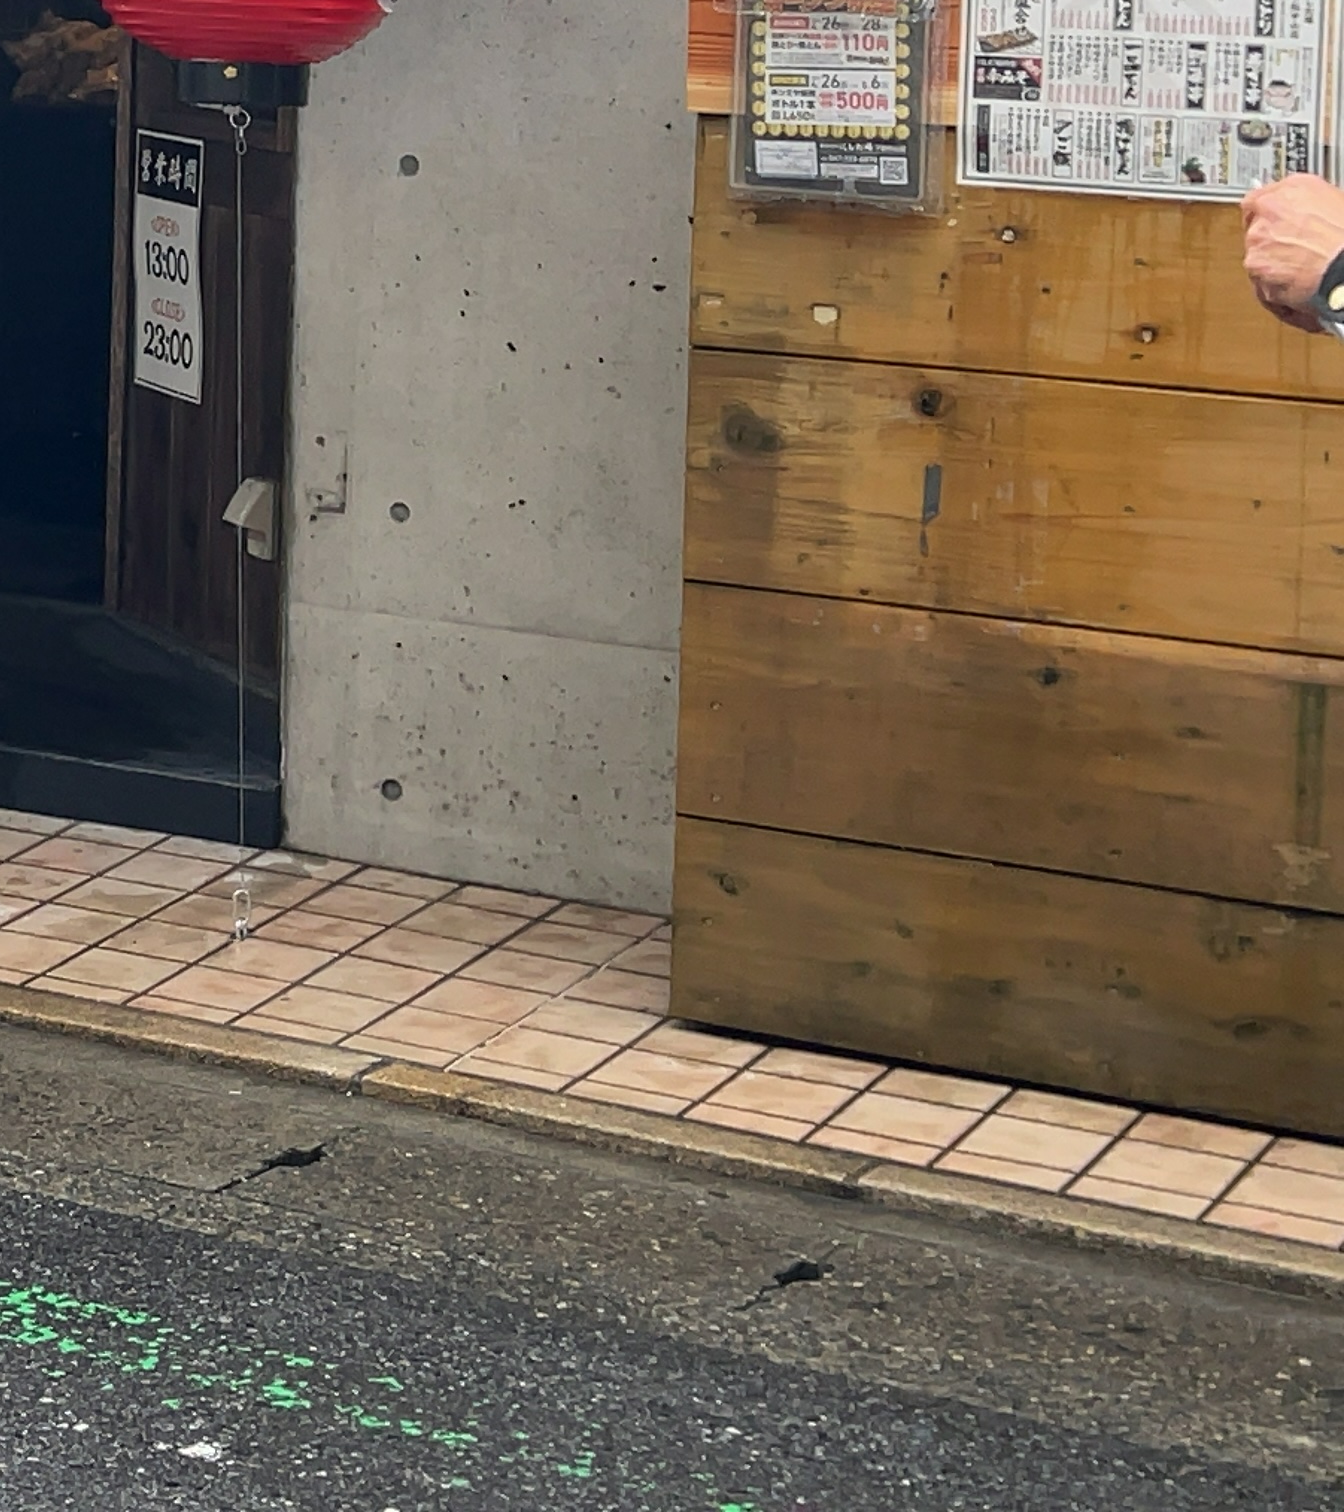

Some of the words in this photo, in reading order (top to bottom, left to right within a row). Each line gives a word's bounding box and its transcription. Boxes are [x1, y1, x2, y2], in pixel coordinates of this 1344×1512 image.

[836, 92, 889, 111] 500円
[144, 240, 189, 285] 13:00
[143, 321, 193, 369] 23:00
